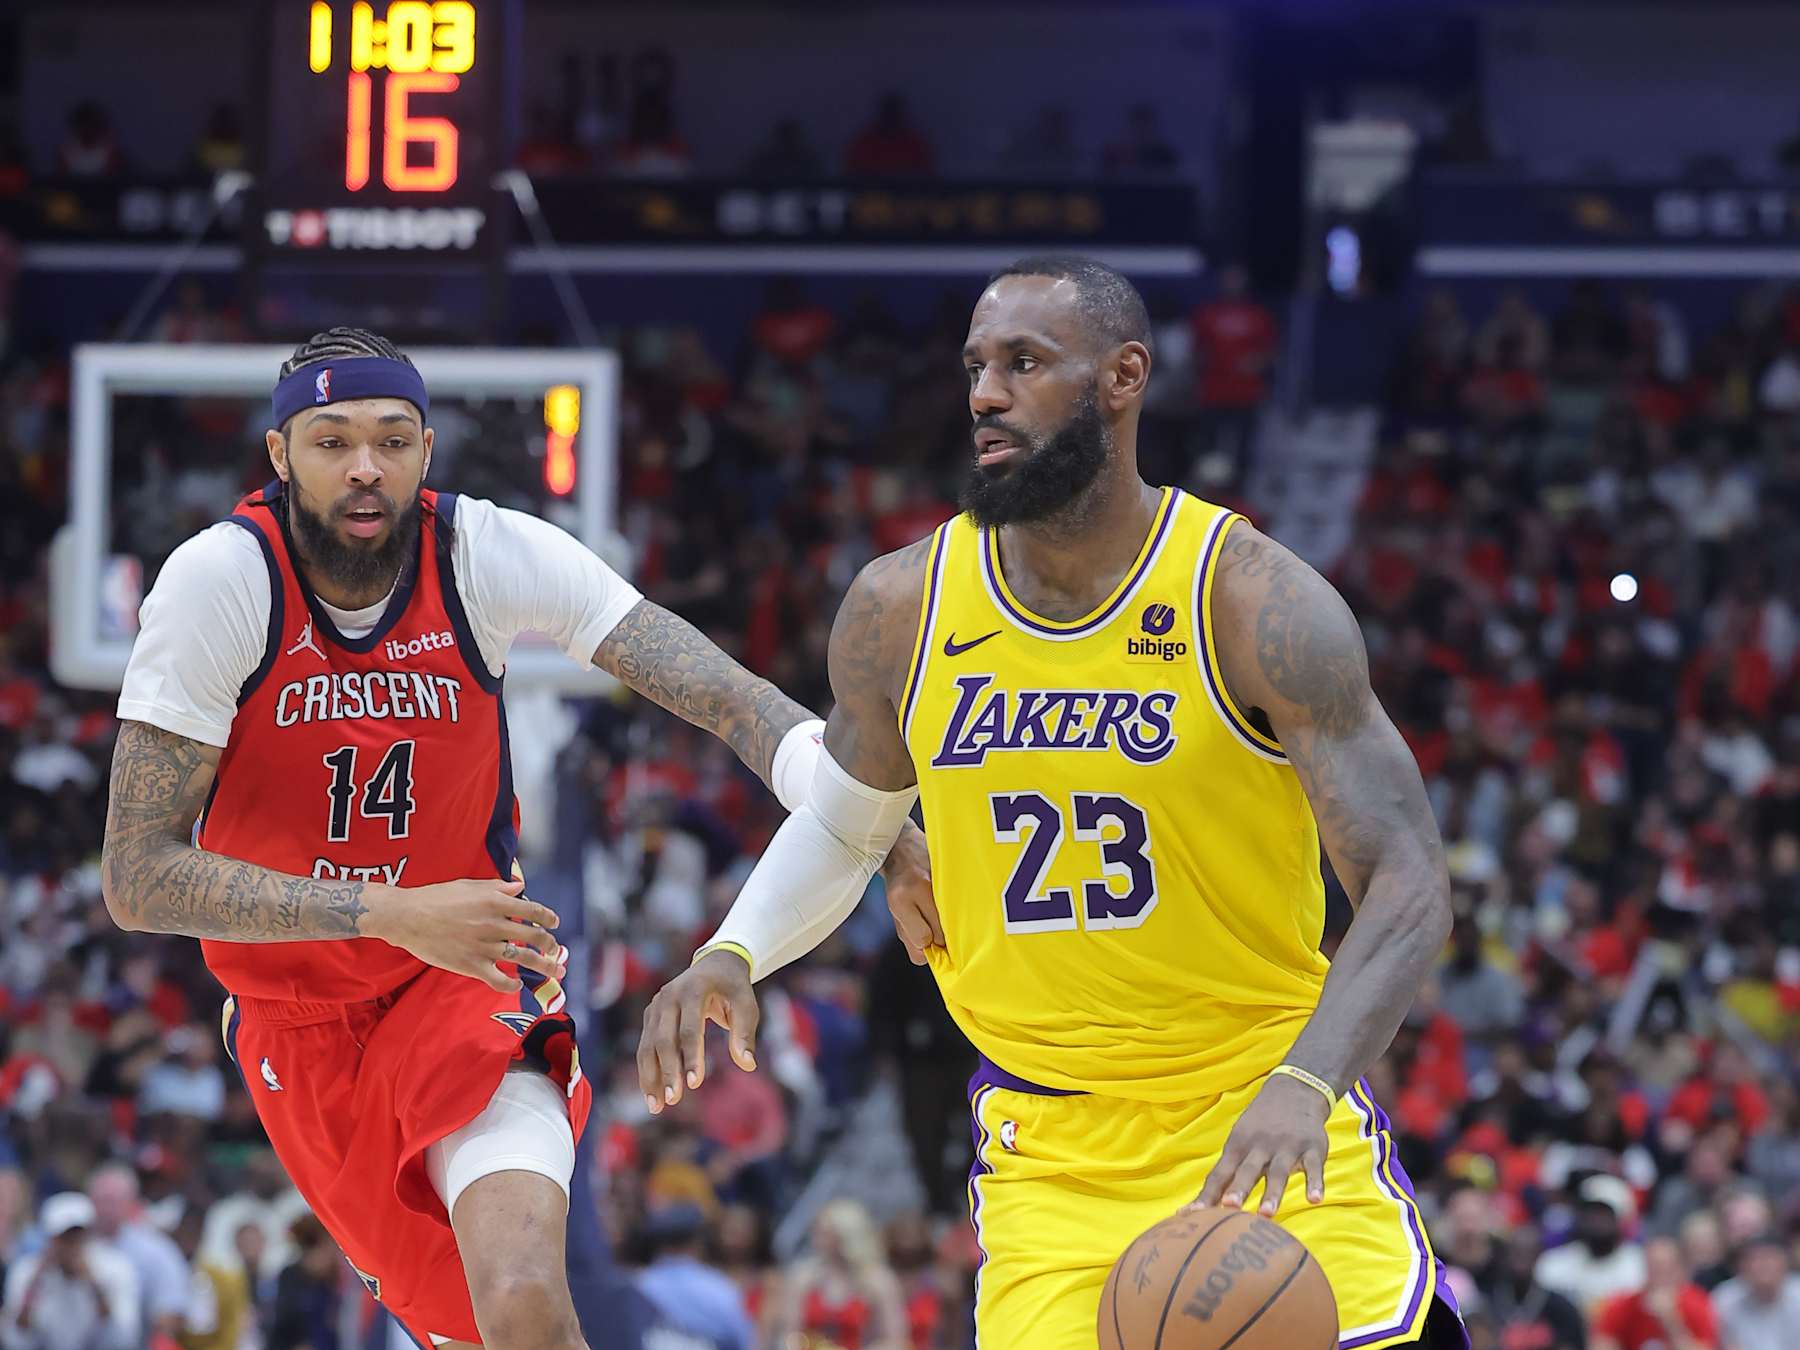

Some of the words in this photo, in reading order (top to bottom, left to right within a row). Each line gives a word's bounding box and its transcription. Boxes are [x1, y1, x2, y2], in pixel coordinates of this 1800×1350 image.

[309, 1, 476, 73] 11:03
[345, 72, 460, 192] 16
[385, 628, 456, 662] ibotta
[1127, 638, 1187, 661] bibigo
[274, 671, 462, 727] CRESCENT
[930, 672, 1179, 769] LAKERS
[322, 739, 416, 842] 14
[988, 790, 1159, 935] 23
